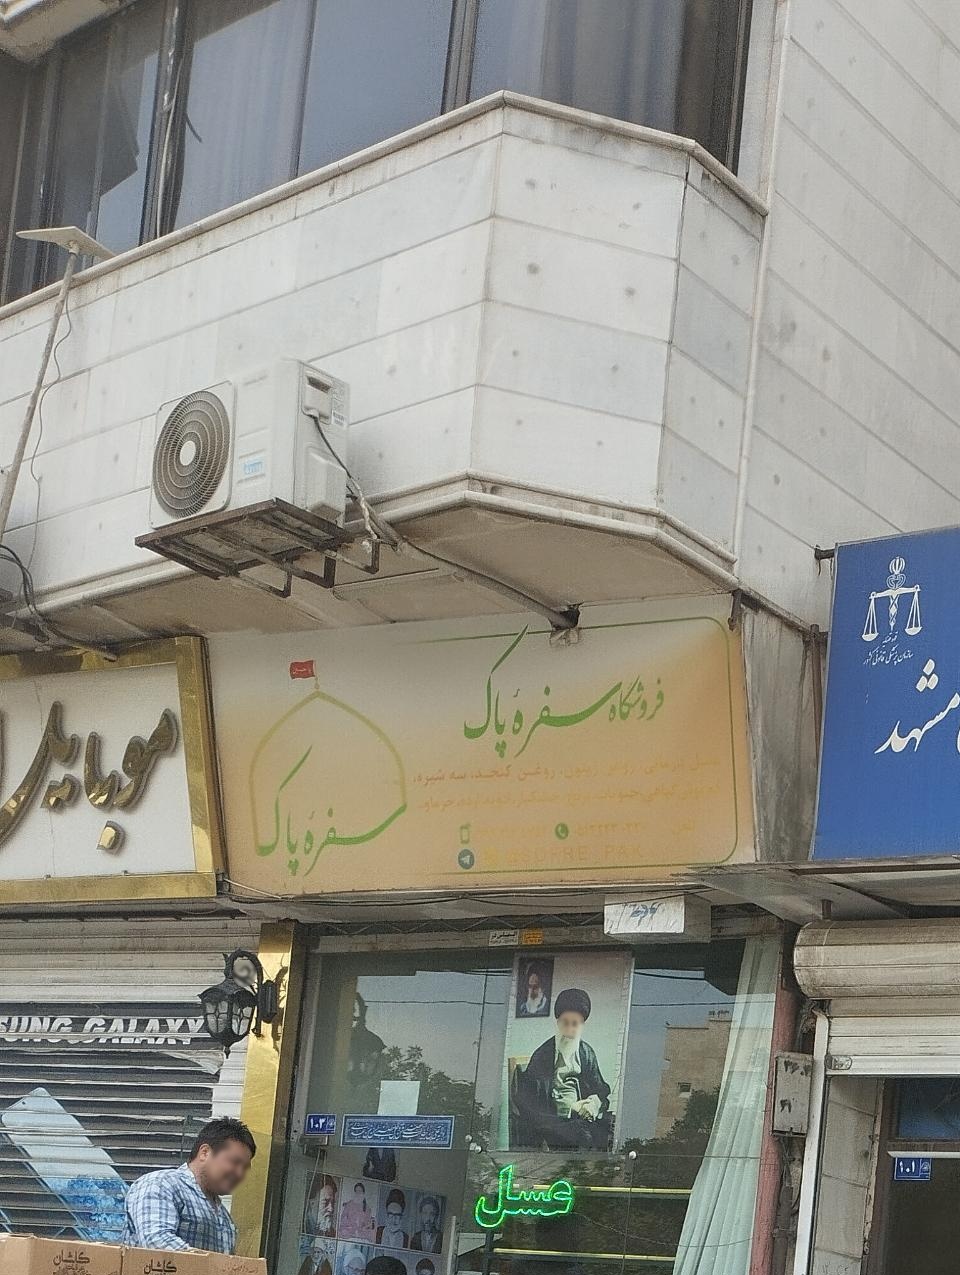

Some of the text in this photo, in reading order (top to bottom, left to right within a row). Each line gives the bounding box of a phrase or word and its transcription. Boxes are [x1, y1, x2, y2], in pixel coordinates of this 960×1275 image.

[464, 624, 528, 758] پاک
[608, 674, 665, 722] فروشگاه
[874, 659, 960, 754] مشهد
[256, 745, 313, 876] پاک
[74, 1015, 205, 1045] GALAXY
[475, 1163, 574, 1229] عسل
[53, 1249, 91, 1266] کاشان
[143, 1258, 178, 1275] کاشان
